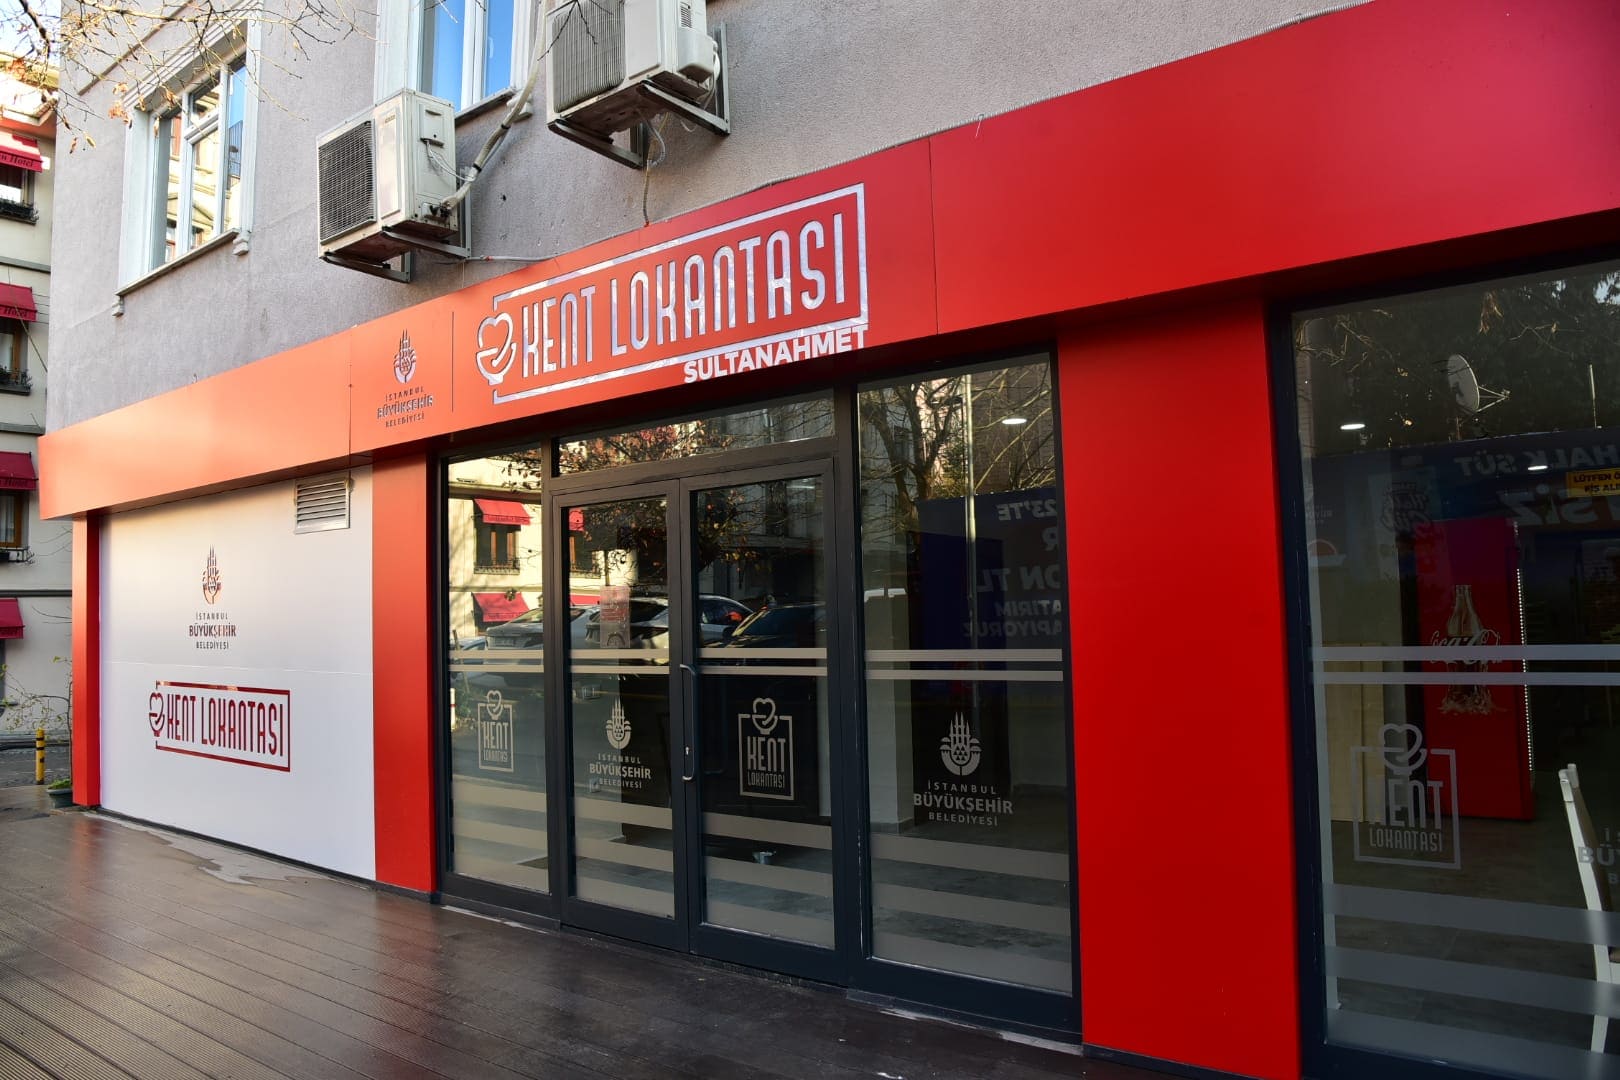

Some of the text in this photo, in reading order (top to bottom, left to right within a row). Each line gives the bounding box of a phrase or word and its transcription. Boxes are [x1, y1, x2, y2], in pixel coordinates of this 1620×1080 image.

[521, 213, 846, 378] KENT LOKANTASI
[683, 325, 870, 384] SULTANAHMET
[188, 622, 237, 639] BÜYÜKŞEHİR
[167, 693, 284, 757] KENT LOKANTASI
[483, 721, 509, 751] KENT
[598, 752, 641, 764] İSTANBUL
[747, 735, 786, 773] KENT
[589, 761, 652, 780] BÜYÜKŞEHİR
[747, 771, 785, 789] LOKANTASI
[927, 778, 998, 795] İSTANBUL
[913, 791, 1014, 815] BÜYÜKŞEHİR
[1366, 777, 1444, 830] KENT
[928, 811, 999, 827] BELEDİYESİ
[1368, 827, 1443, 852] LOKANTASI
